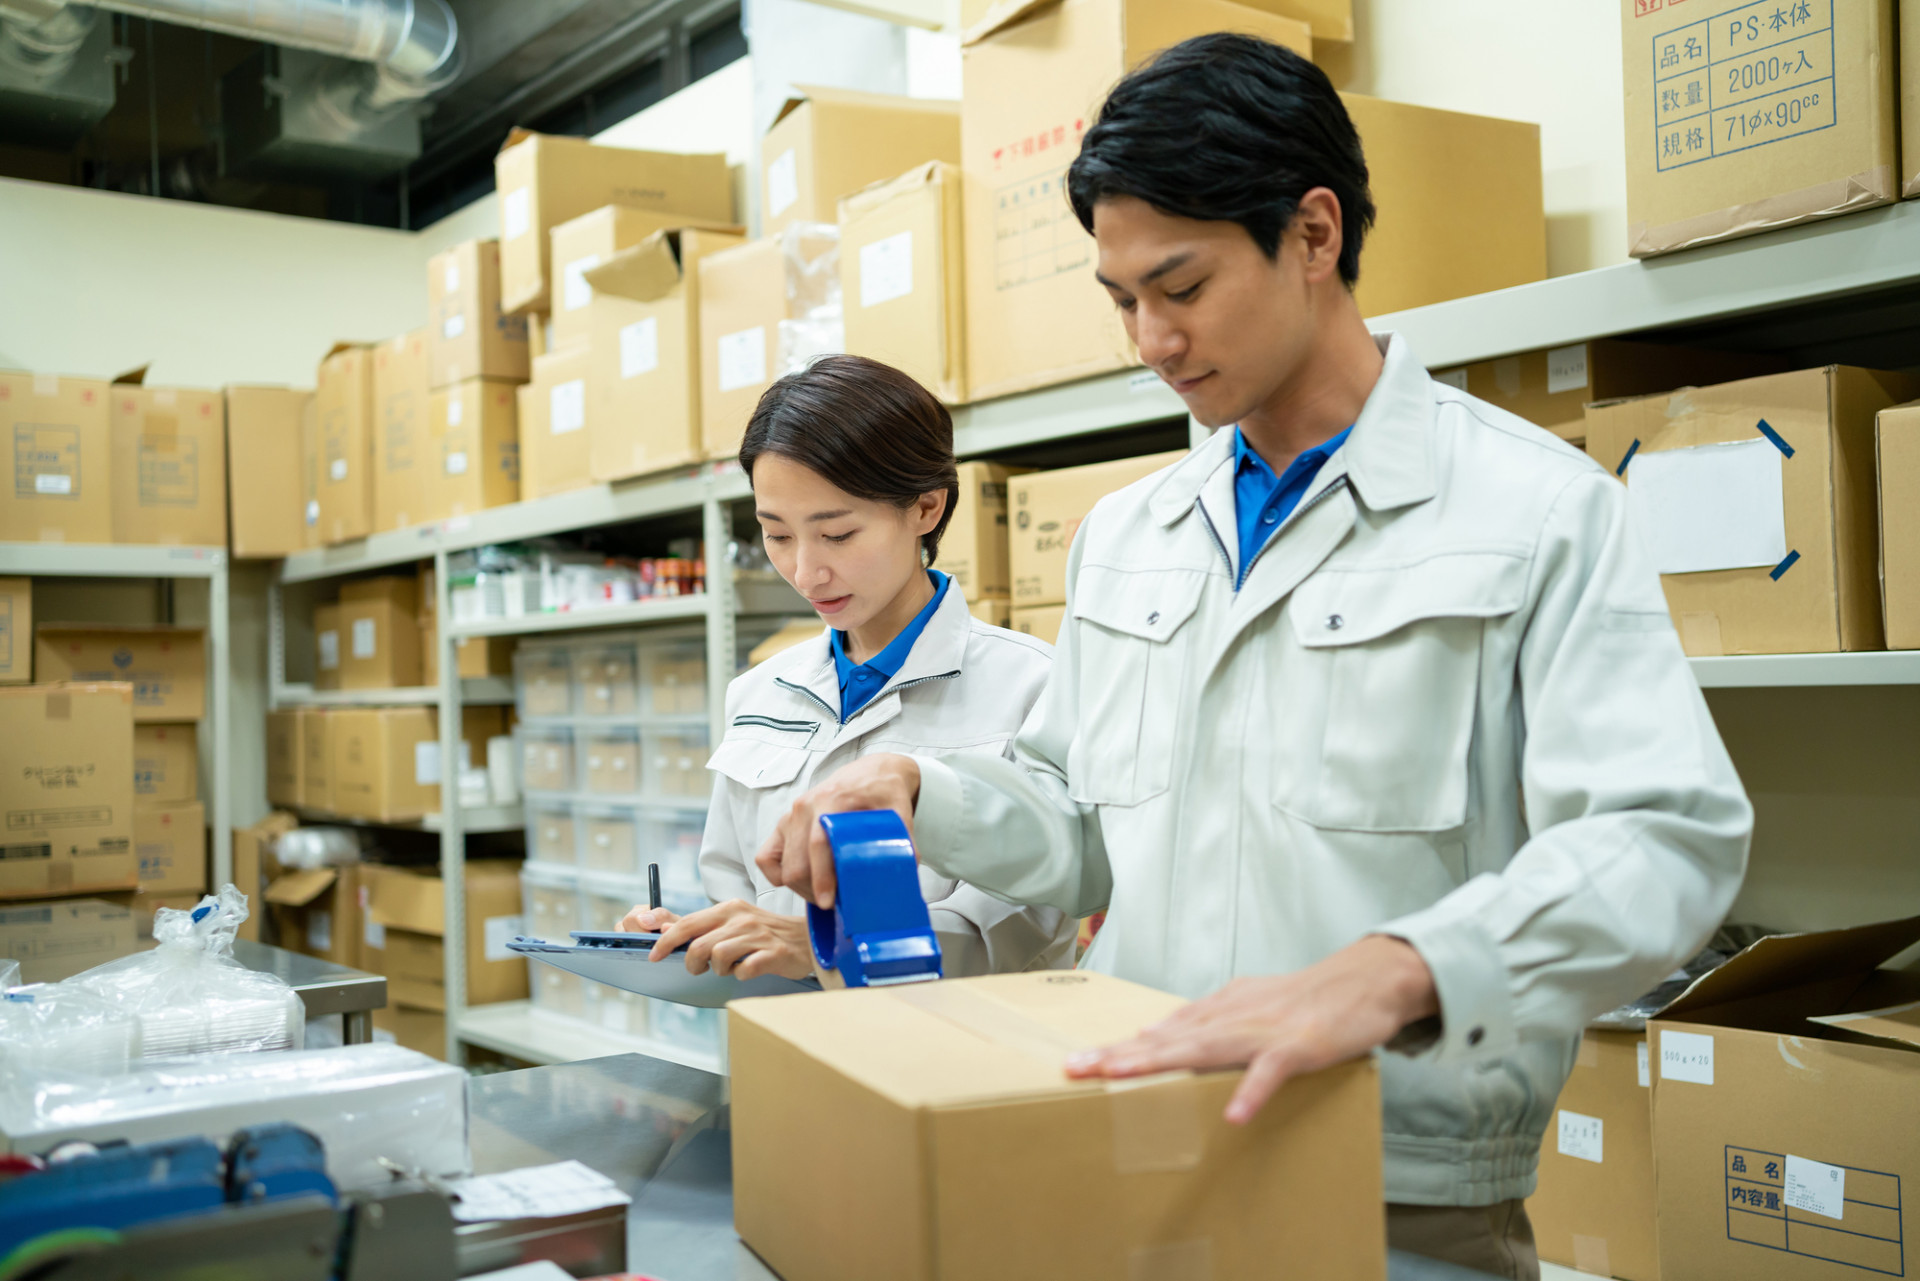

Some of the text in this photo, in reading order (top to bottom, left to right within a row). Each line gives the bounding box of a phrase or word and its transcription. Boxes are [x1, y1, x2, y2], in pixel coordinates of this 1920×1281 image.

[1660, 37, 1702, 69] 品名
[1661, 81, 1704, 113] 数量
[1662, 127, 1705, 158] 規格
[1732, 1186, 1781, 1211] 内容量
